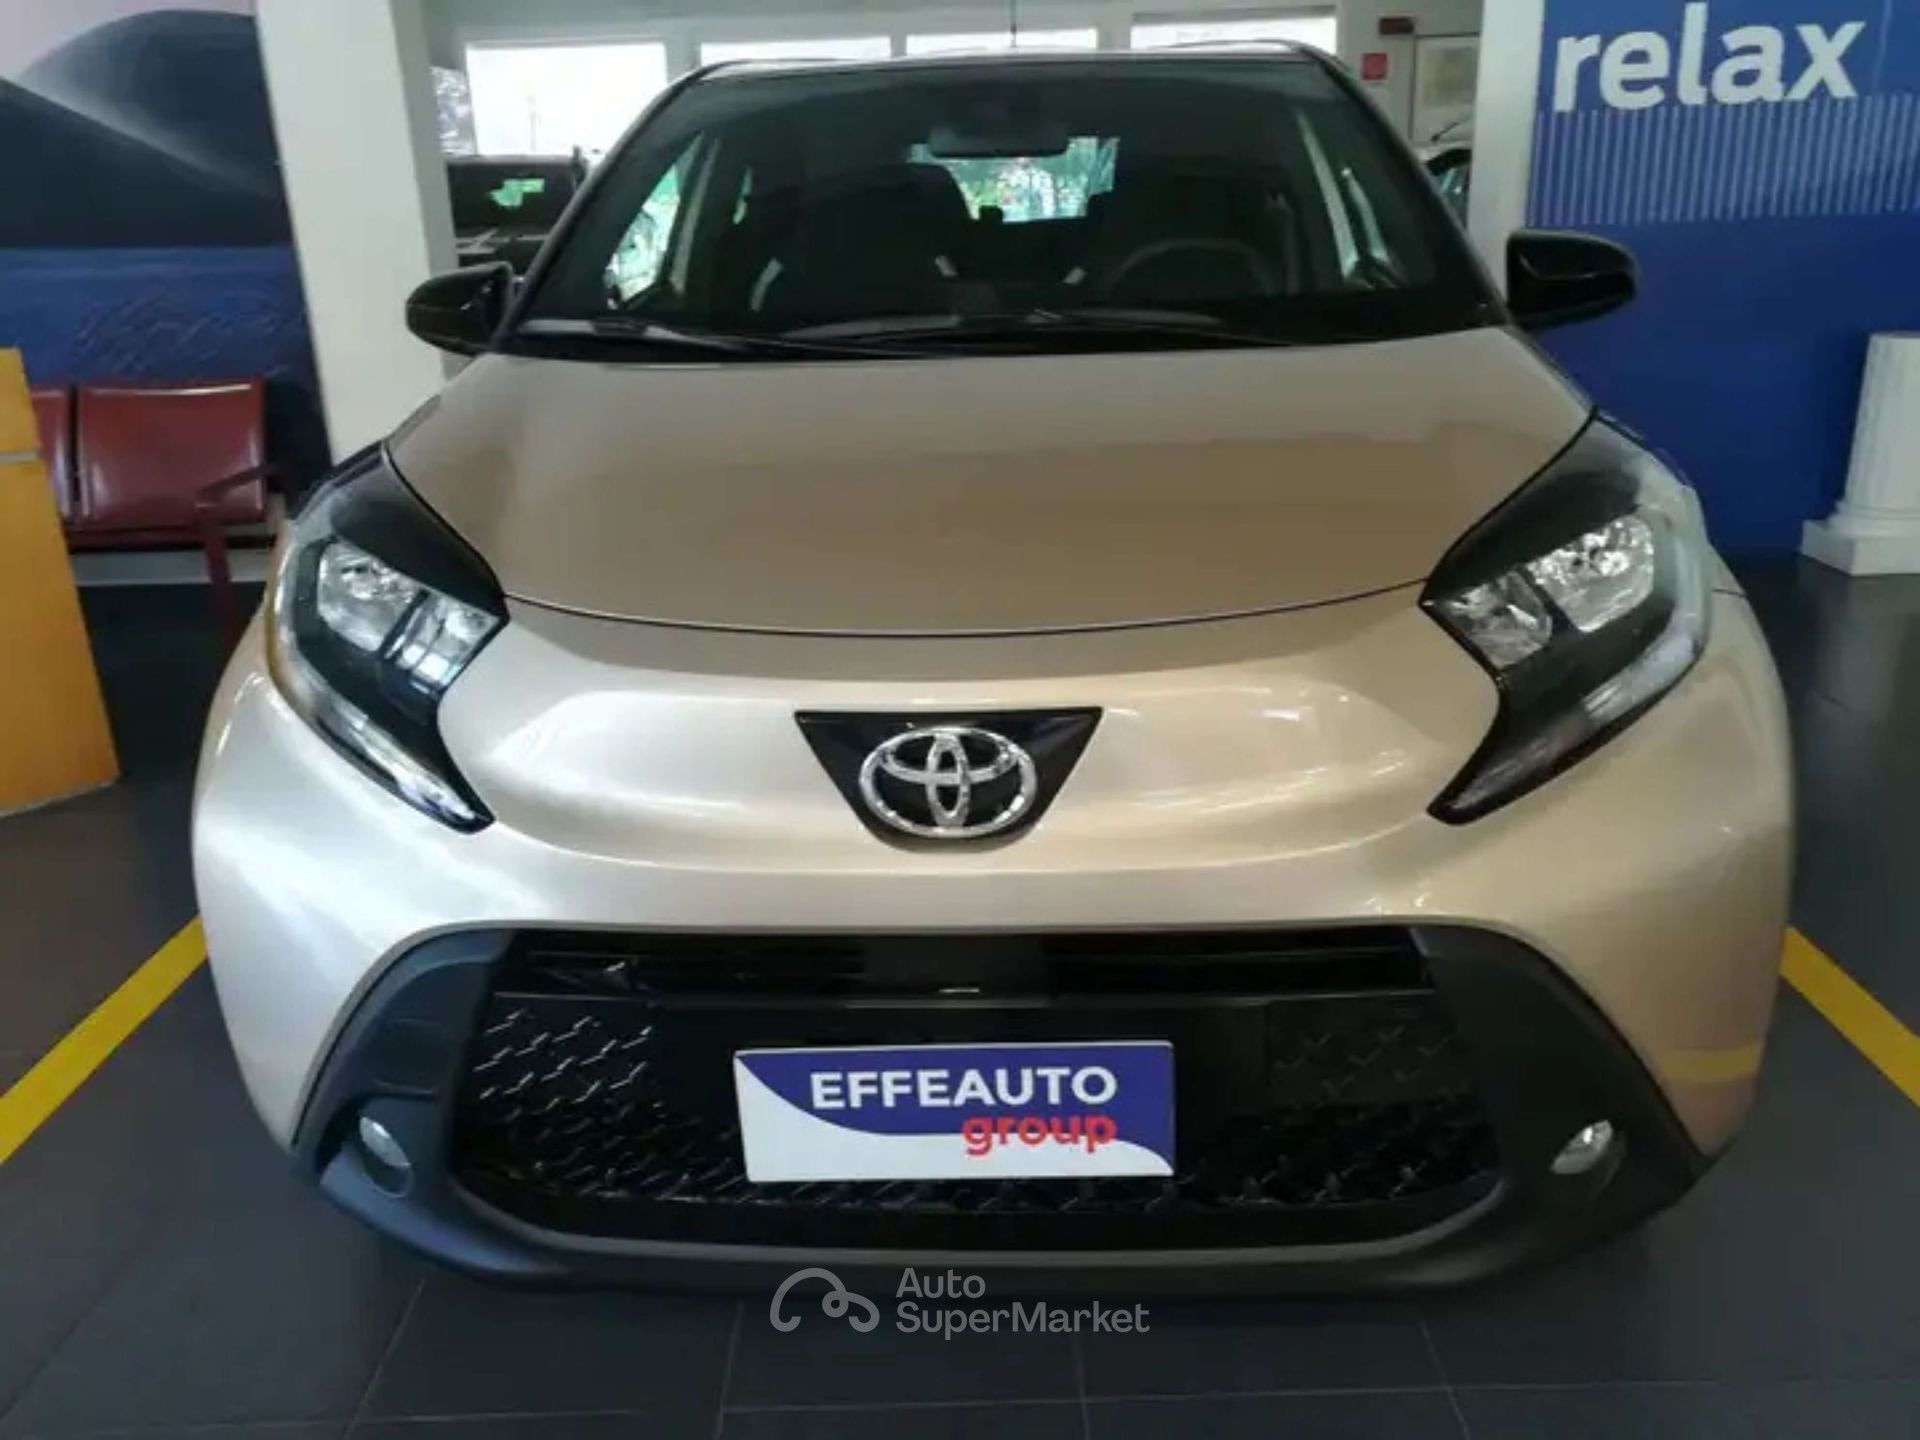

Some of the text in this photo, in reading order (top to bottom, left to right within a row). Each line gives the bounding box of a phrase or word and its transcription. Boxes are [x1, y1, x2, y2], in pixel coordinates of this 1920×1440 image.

[1552, 2, 1867, 113] relax
[810, 1066, 1118, 1109] EFFEAUTO
[961, 1114, 1117, 1156] group
